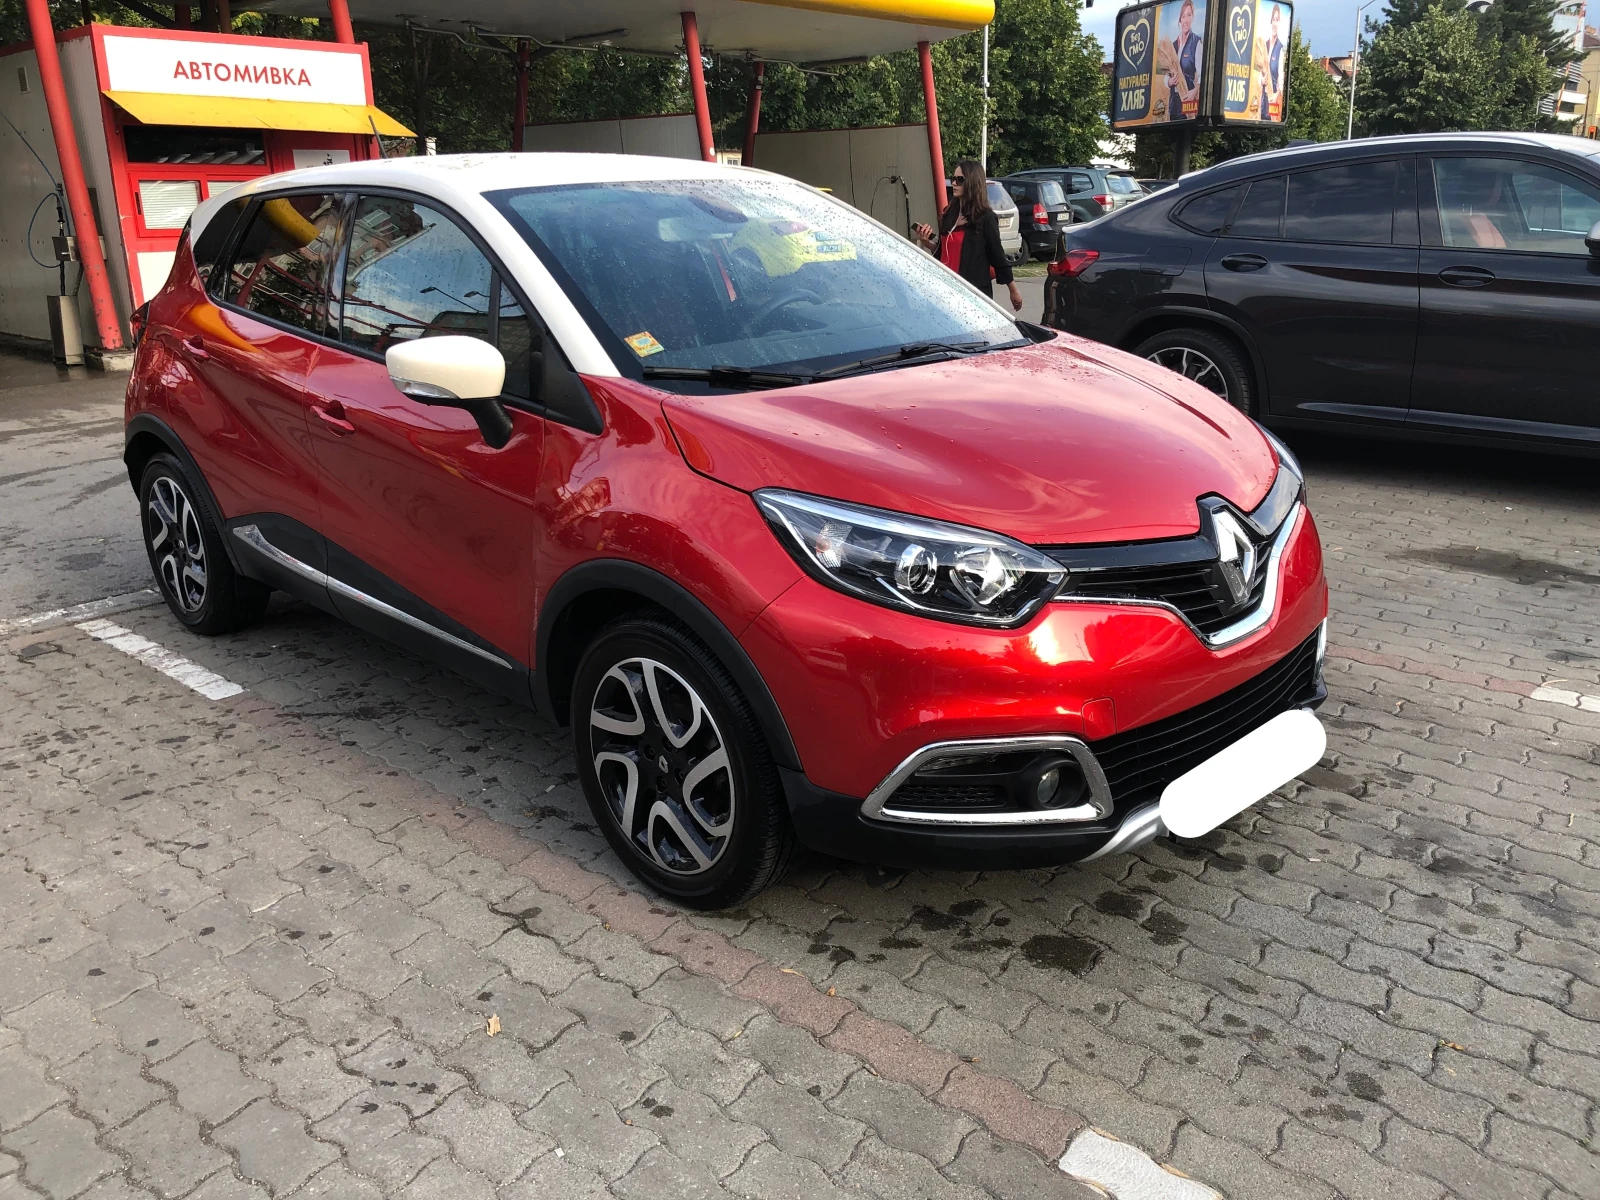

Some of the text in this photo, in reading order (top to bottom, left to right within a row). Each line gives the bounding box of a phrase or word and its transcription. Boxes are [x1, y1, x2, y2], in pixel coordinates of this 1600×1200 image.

[1129, 41, 1145, 57] ГМО
[173, 60, 312, 87] АВТОМИВКА
[1121, 89, 1145, 111] ХЛЯБ
[1227, 79, 1245, 102] ХЛЯБ
[1182, 102, 1197, 112] BILLA
